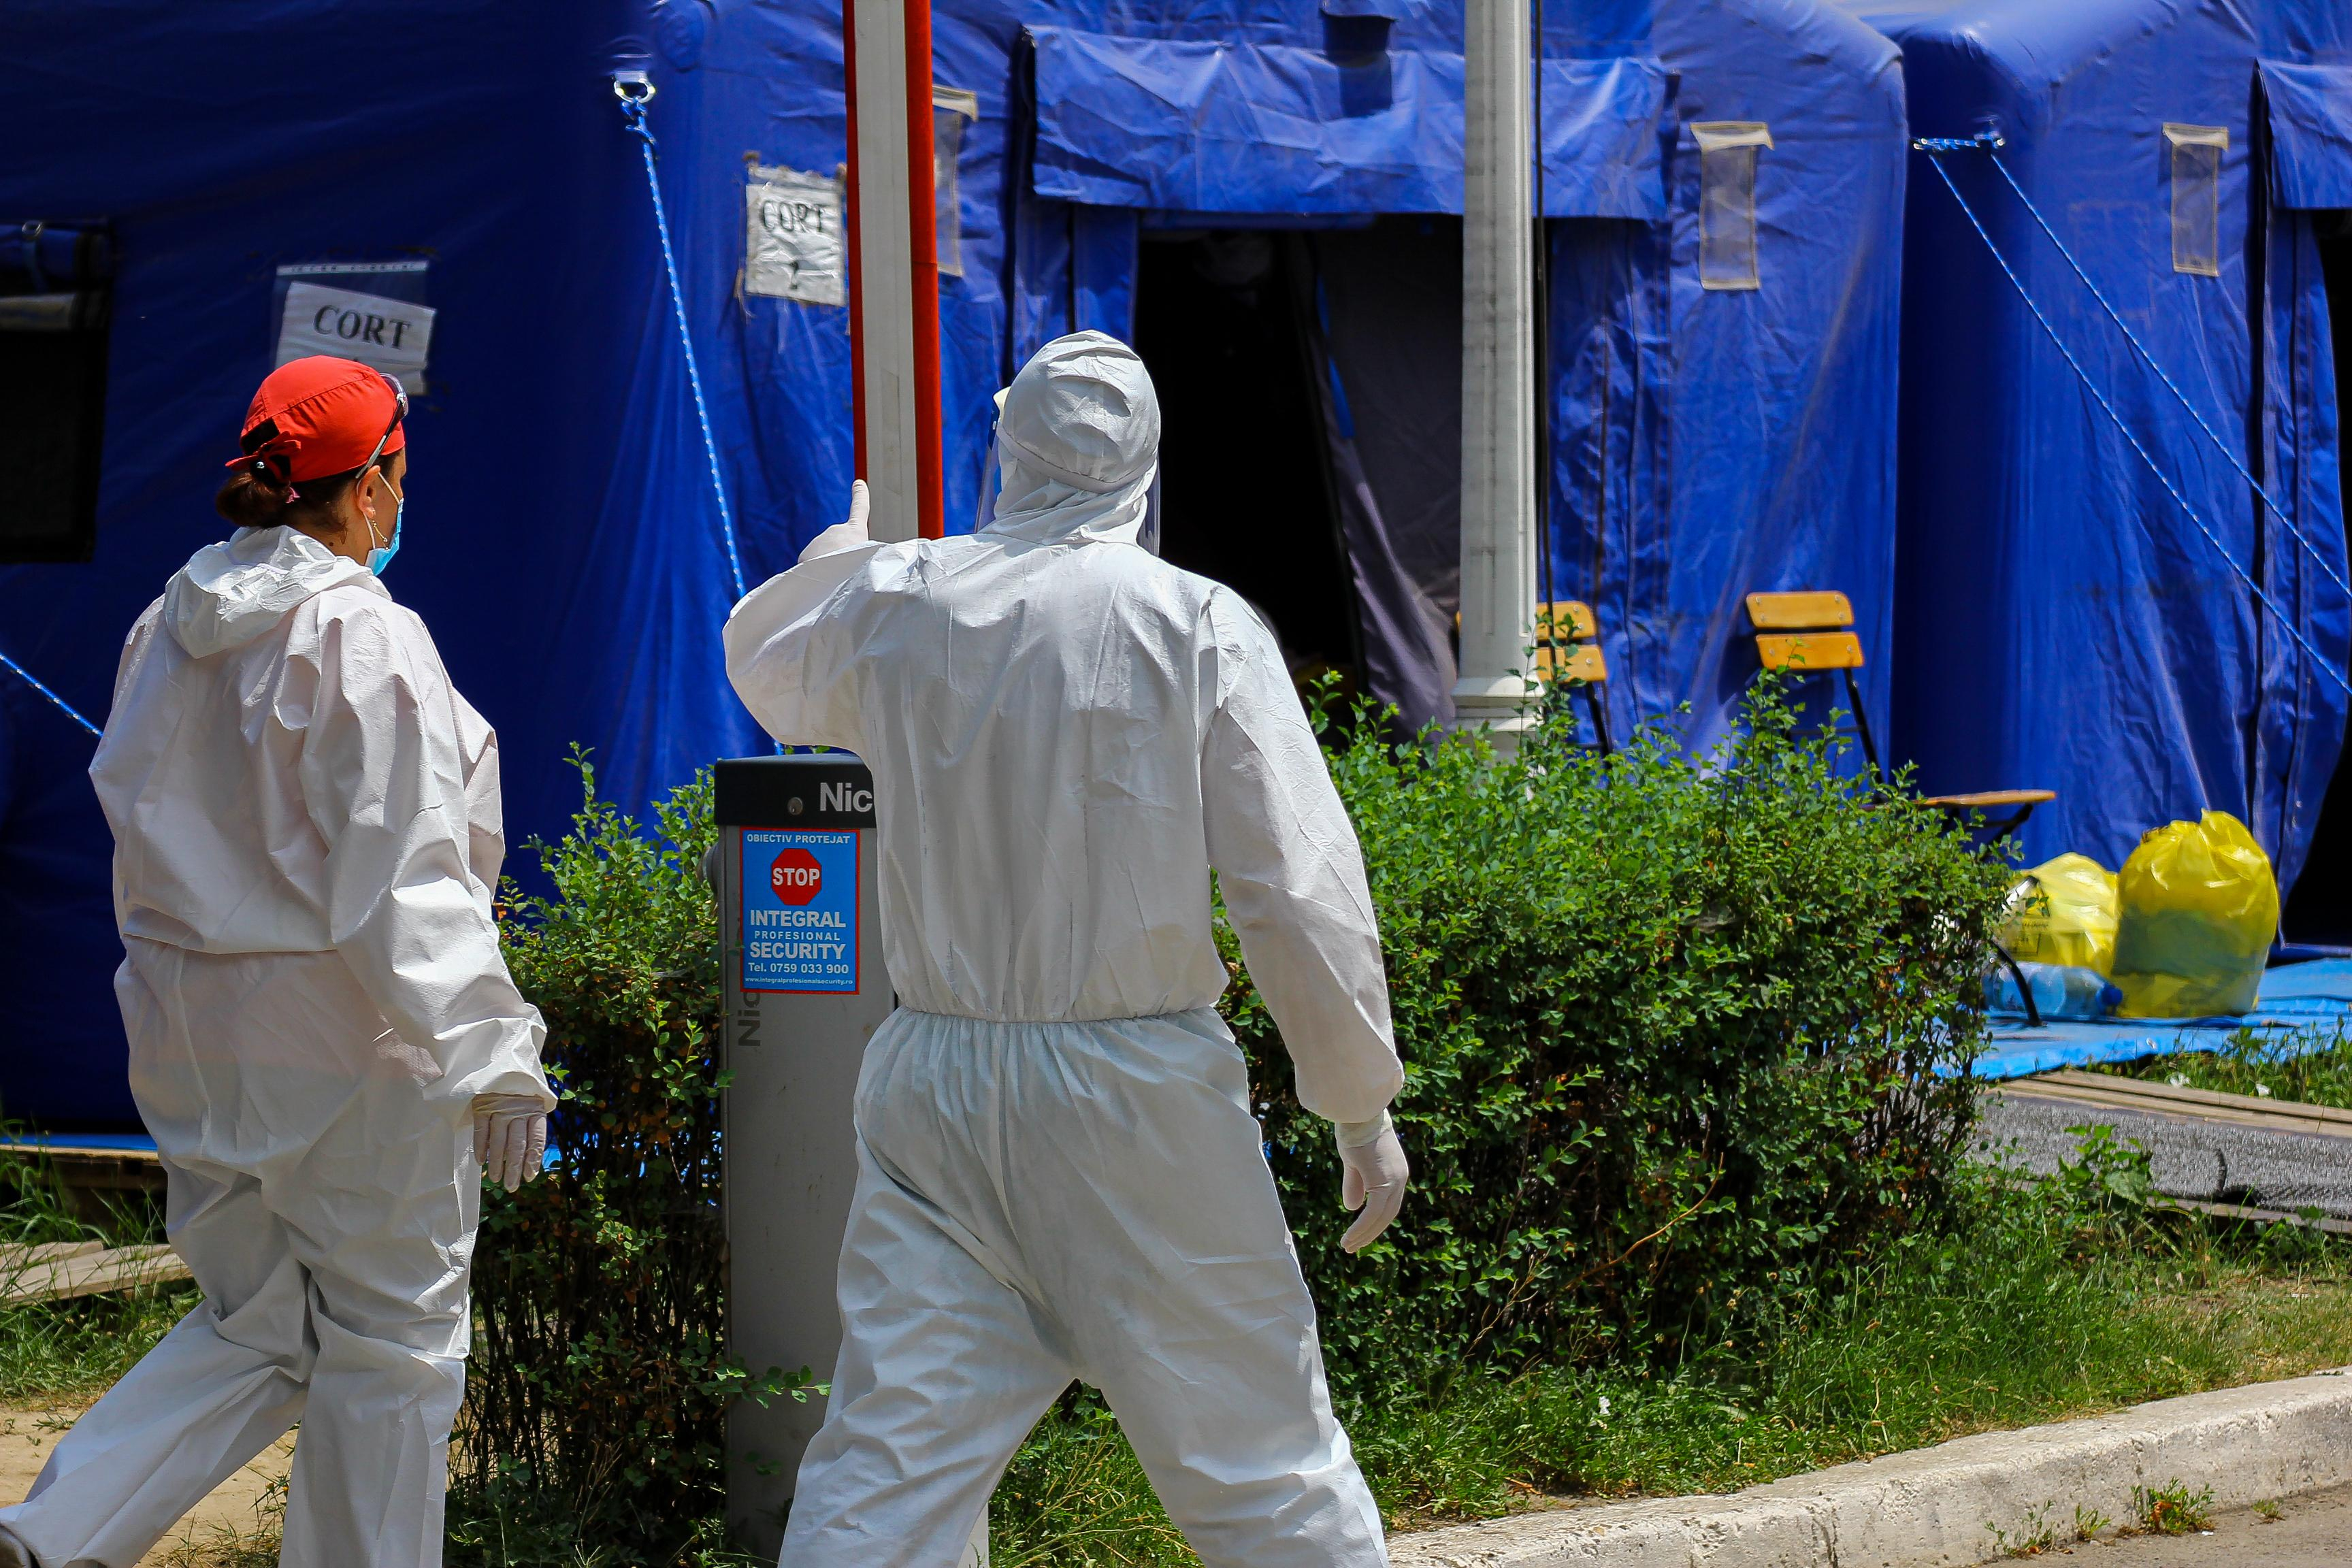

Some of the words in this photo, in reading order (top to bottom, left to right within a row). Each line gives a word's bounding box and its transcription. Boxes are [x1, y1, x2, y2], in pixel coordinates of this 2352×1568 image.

[761, 201, 828, 232] CORT
[313, 304, 412, 350] CORT
[747, 834, 792, 843] OBIECTIV
[795, 835, 850, 844] PROTEJAT
[772, 867, 820, 887] STOP
[750, 909, 846, 928] INTEGRAL
[754, 930, 840, 941] PROFESIONAL
[749, 941, 846, 960] SECURITY
[748, 962, 767, 973] Tel.
[770, 963, 797, 973] 0759
[800, 964, 823, 974] 033
[826, 964, 849, 975] 900
